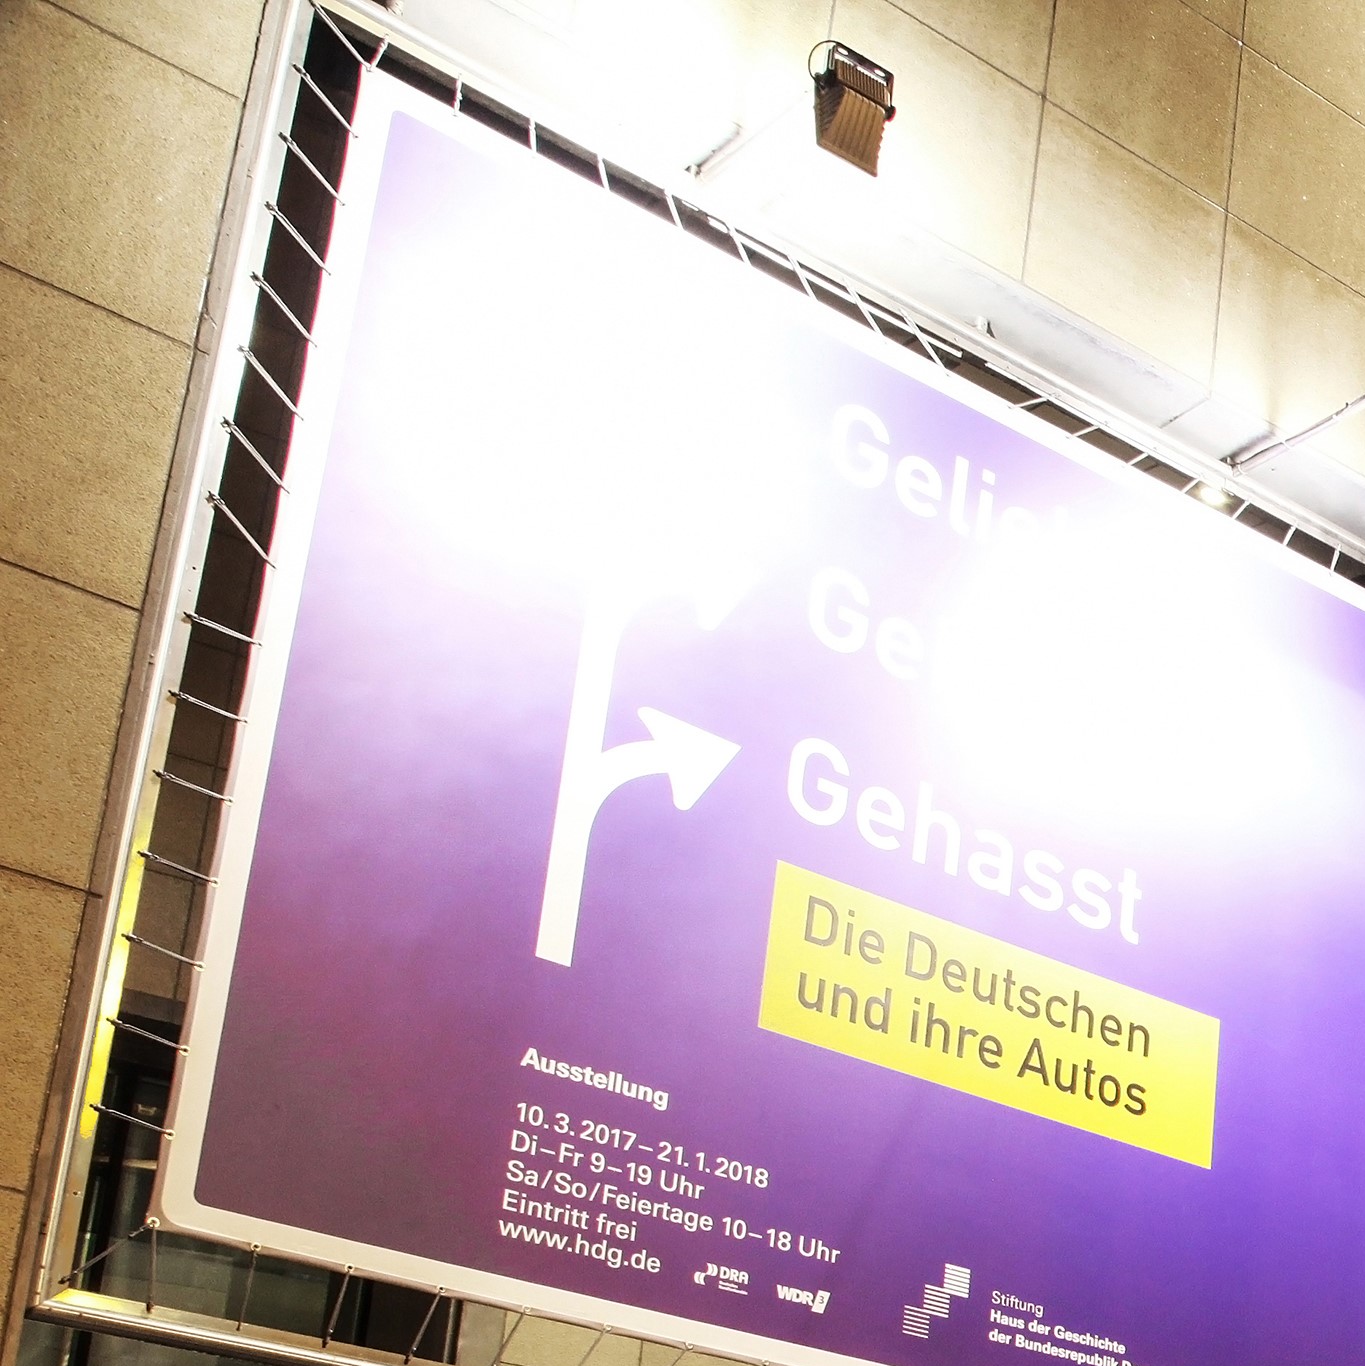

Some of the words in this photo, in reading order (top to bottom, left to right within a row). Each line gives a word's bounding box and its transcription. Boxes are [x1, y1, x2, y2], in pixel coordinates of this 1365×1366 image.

[786, 738, 1143, 945] Gehasst
[804, 895, 885, 964] Die
[905, 932, 1150, 1057] Deutschen
[797, 971, 891, 1034] und
[910, 997, 1002, 1069] ihre
[1017, 1037, 1147, 1116] Autos
[520, 1047, 669, 1111] Ausstellung
[660, 1169, 705, 1199] Uhr
[502, 1188, 589, 1230] Eintritt
[596, 1213, 638, 1241] frei
[499, 1219, 661, 1273] www.hdg.de
[798, 1235, 840, 1263] Uhr
[719, 1266, 749, 1284] DRA
[991, 1290, 1044, 1317] Stiftung
[988, 1329, 1012, 1345] der
[990, 1309, 1025, 1329] Haus
[1028, 1320, 1051, 1335] der
[1053, 1325, 1126, 1355] Geschichte
